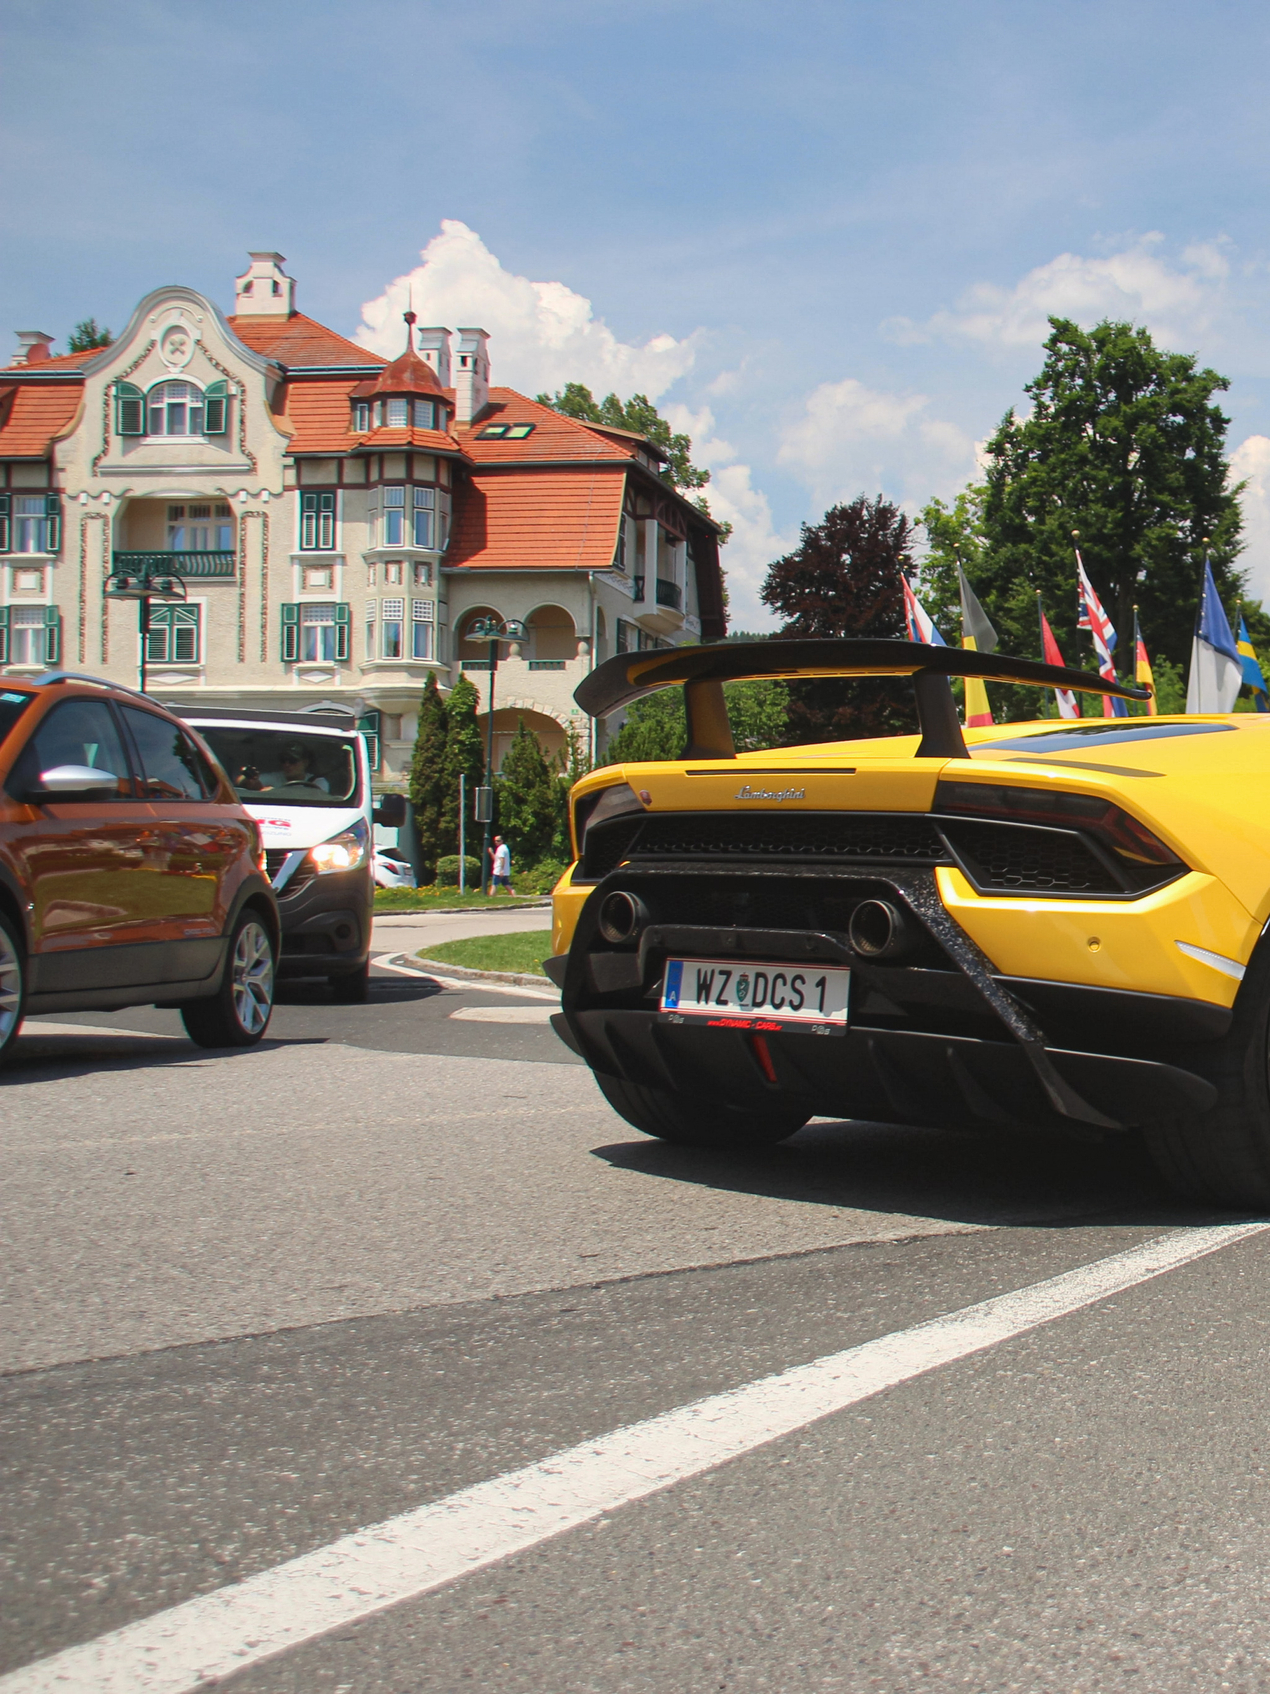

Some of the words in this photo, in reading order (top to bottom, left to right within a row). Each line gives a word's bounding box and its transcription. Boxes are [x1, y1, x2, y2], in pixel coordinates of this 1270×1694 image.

[734, 785, 806, 802] Lamborghini
[696, 968, 732, 1006] WZ
[752, 971, 806, 1011] DCS
[815, 975, 827, 1013] 1
